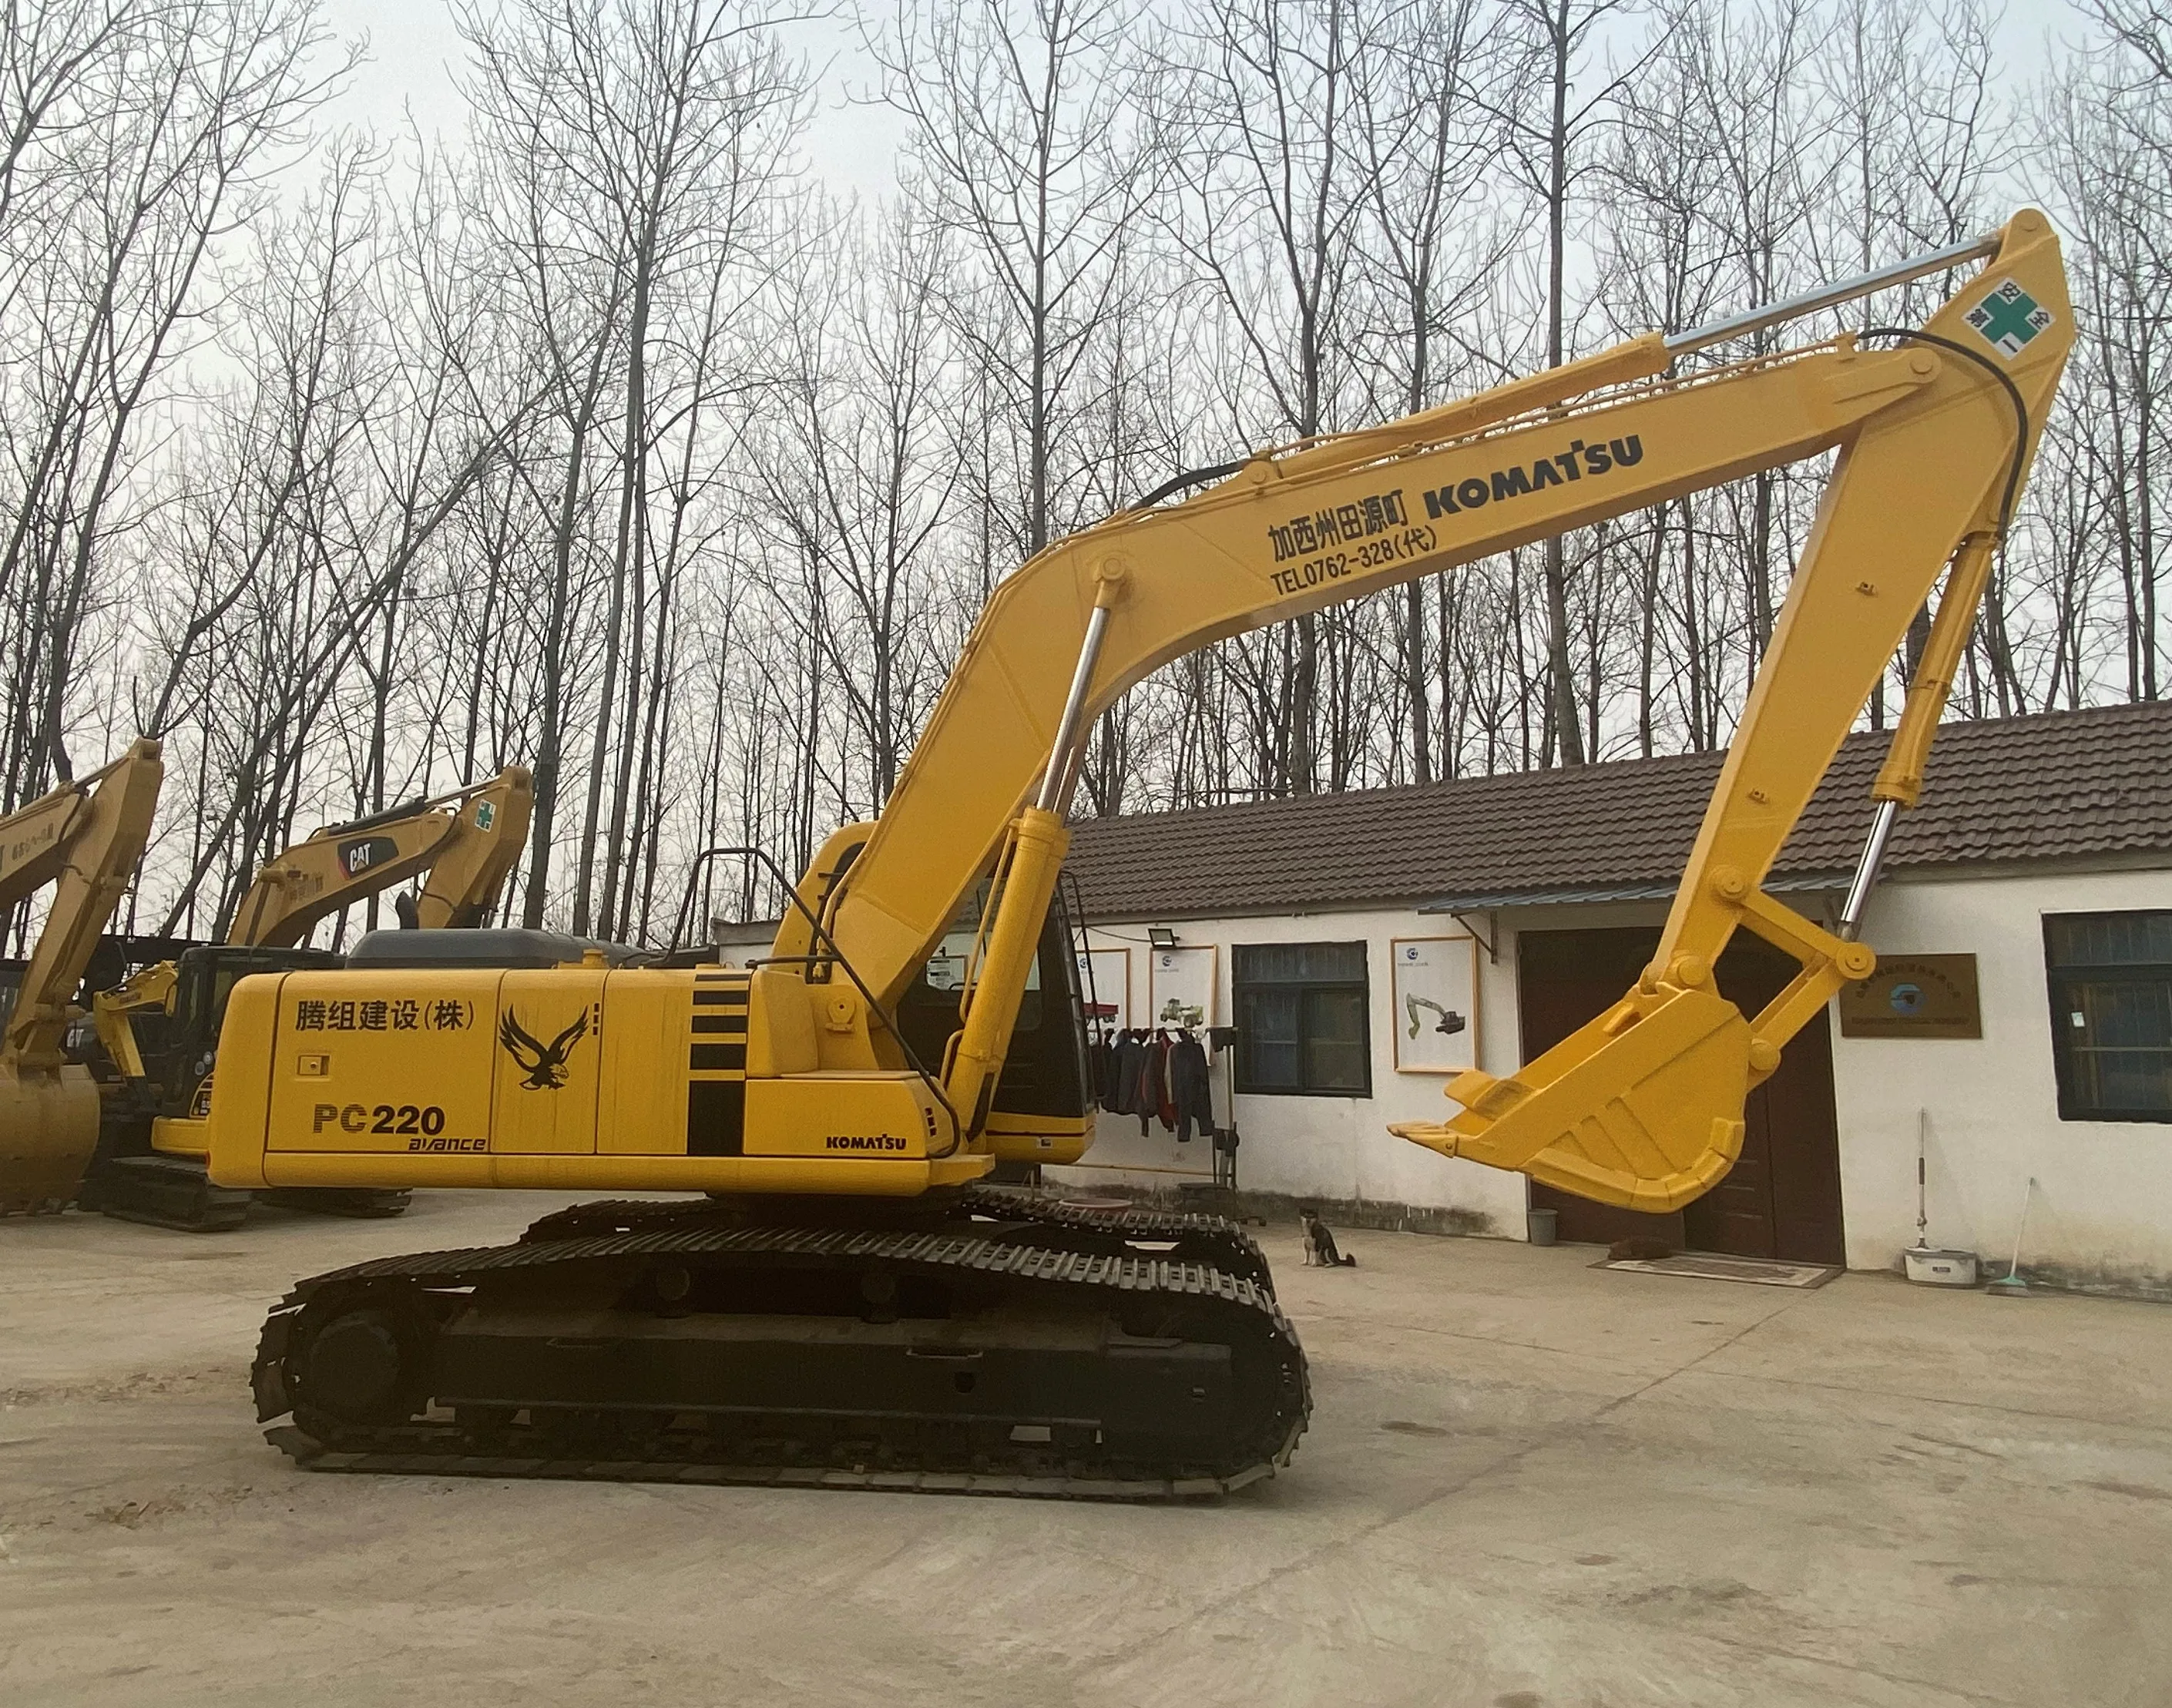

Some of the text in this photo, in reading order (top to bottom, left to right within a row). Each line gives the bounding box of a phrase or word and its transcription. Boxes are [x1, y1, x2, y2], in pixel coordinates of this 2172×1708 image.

[1422, 434, 1644, 520] KOMATSU
[1267, 488, 1409, 562] 加西州田源町
[349, 843, 371, 872] CAT
[408, 1137, 487, 1151] avance
[826, 1133, 907, 1150] KOMATSU
